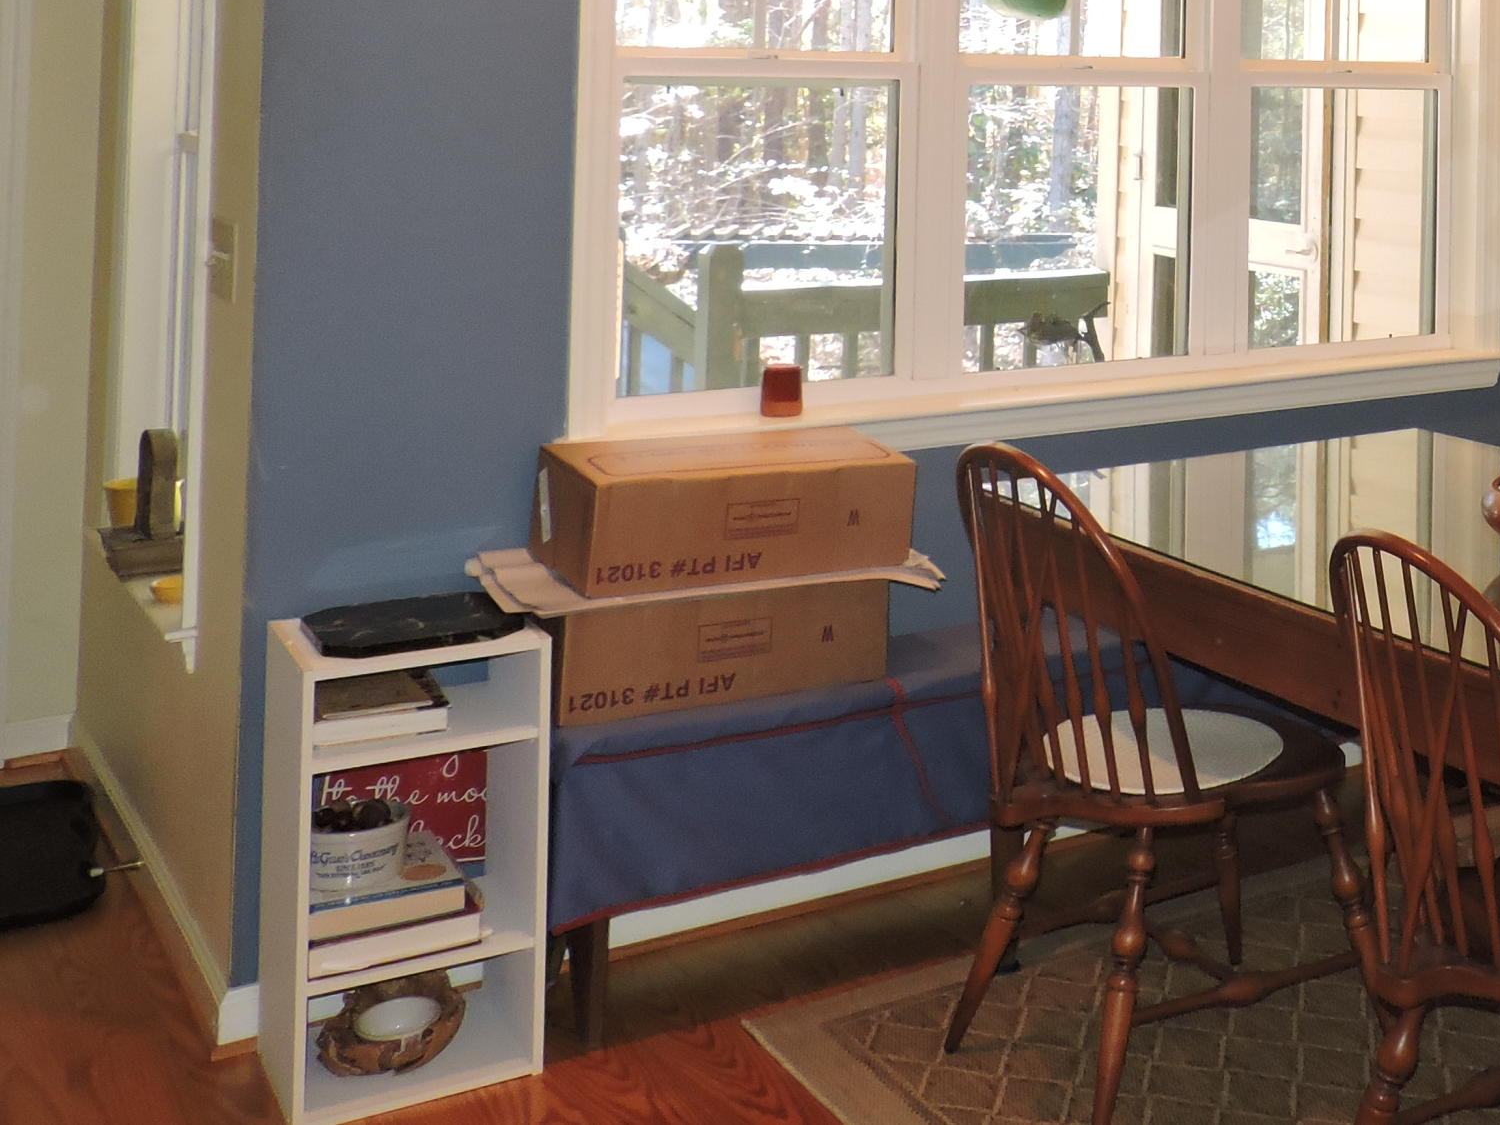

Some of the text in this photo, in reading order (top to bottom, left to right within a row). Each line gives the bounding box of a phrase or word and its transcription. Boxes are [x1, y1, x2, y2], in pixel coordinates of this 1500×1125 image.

[596, 552, 762, 585] AFI PT# 31021
[568, 673, 736, 714] AFI PT# 31021
[366, 775, 429, 805] the
